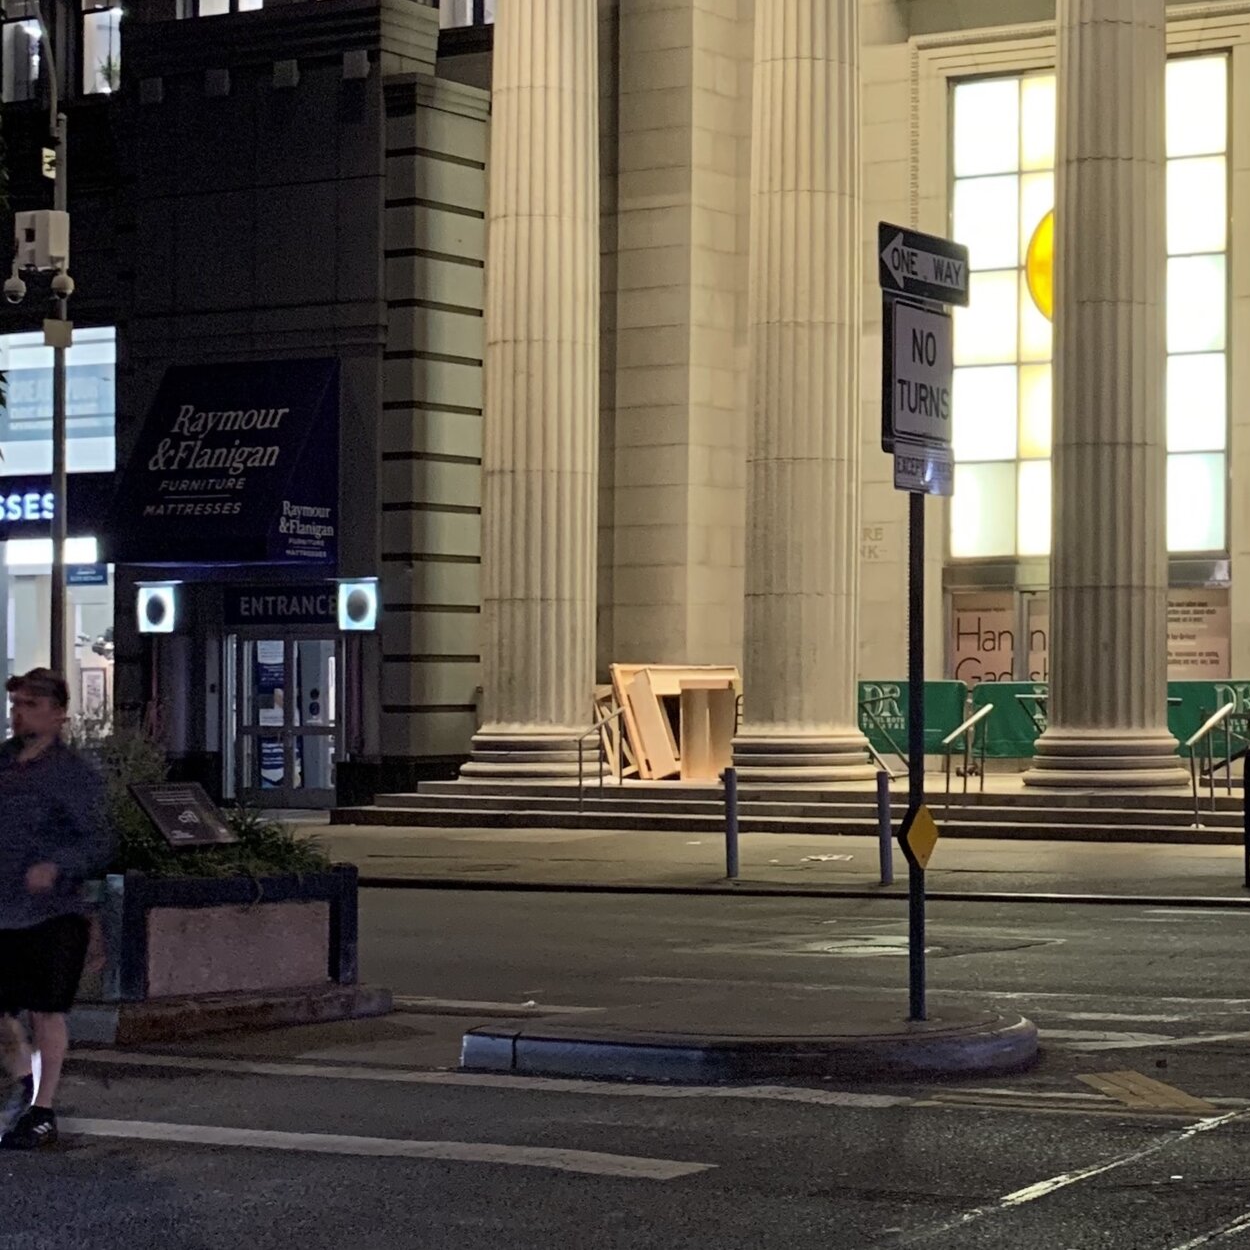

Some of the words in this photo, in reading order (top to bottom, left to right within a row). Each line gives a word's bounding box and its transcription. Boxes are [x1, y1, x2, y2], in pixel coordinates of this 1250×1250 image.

[891, 247, 918, 277] ONE
[933, 257, 962, 287] WAY
[912, 328, 937, 368] NO
[897, 378, 949, 421] TURNS
[170, 404, 290, 438] Raymour
[158, 478, 247, 492] FURNITURE
[143, 502, 243, 517] MATTRESSES
[282, 500, 331, 519] Raymour
[239, 596, 338, 617] ENTRANCE
